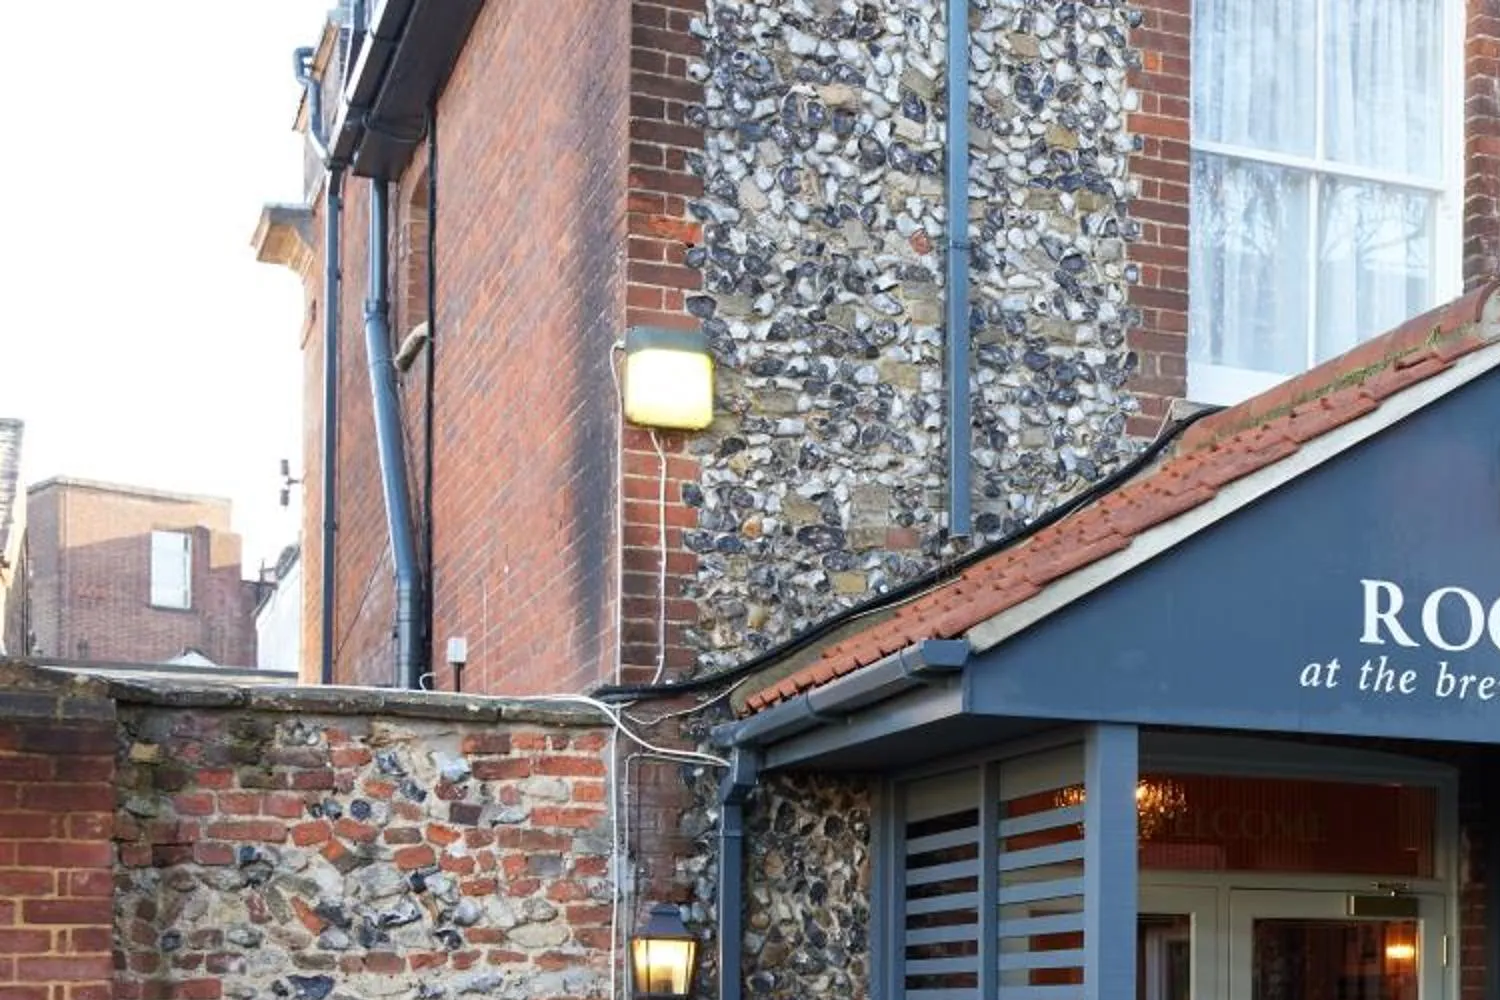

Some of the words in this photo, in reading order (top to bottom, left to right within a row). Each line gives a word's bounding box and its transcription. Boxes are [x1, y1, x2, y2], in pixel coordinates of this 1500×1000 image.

[1300, 657, 1341, 689] at
[1358, 655, 1418, 694] the
[1145, 805, 1328, 843] ELCOME
